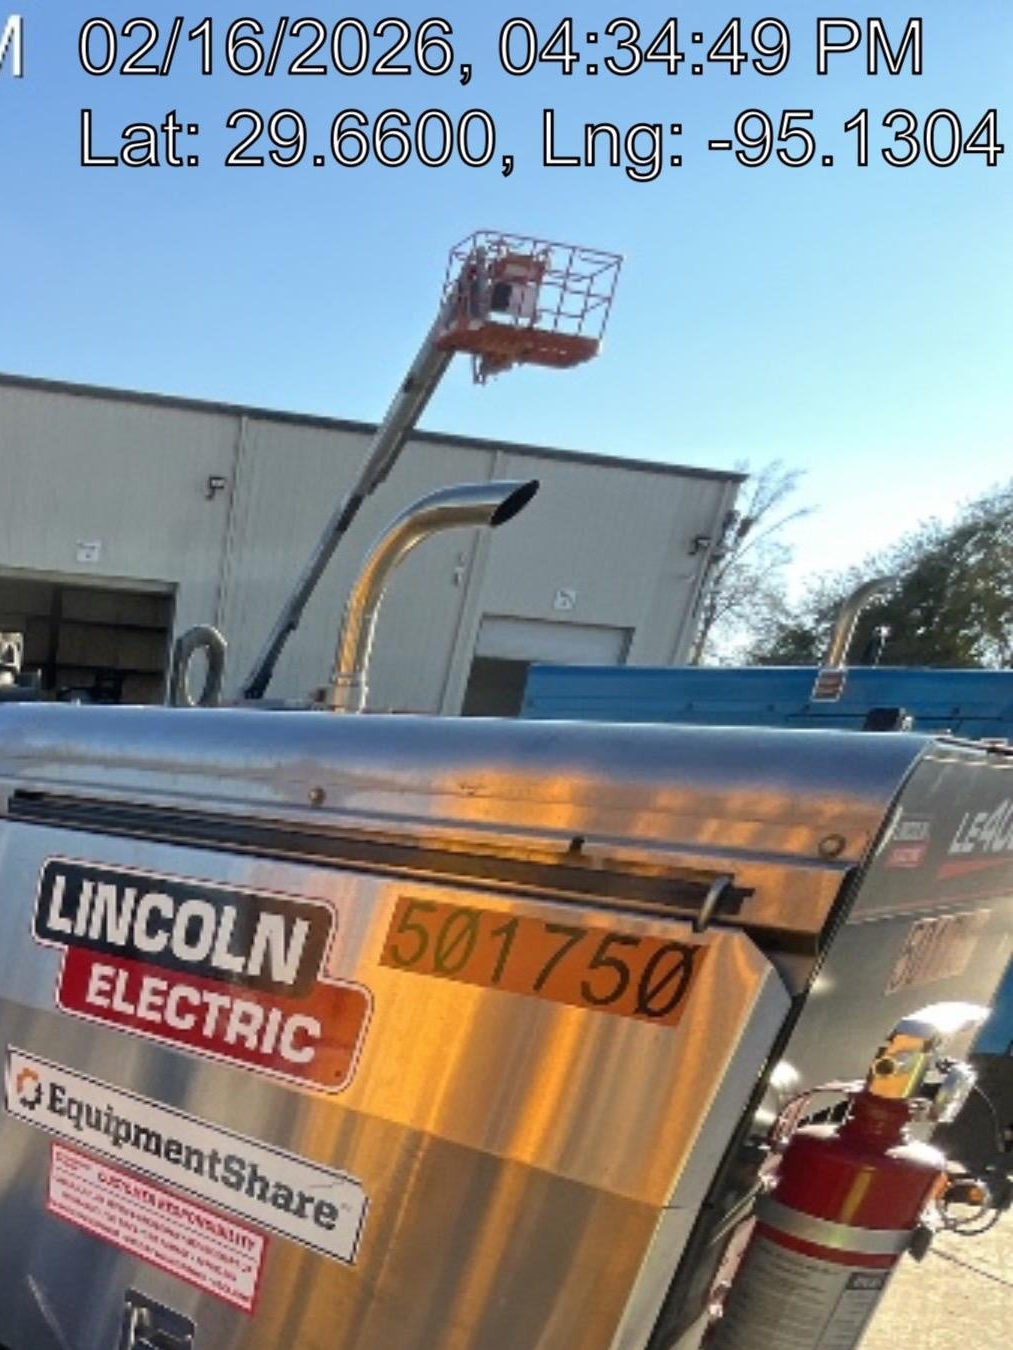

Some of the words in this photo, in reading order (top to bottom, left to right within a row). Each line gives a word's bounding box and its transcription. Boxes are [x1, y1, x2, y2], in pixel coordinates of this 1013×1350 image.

[46, 873, 310, 986] LINCOLN
[390, 902, 702, 1018] 501750
[85, 962, 322, 1064] ELECTRIC
[47, 1081, 340, 1232] EquipmentShare
